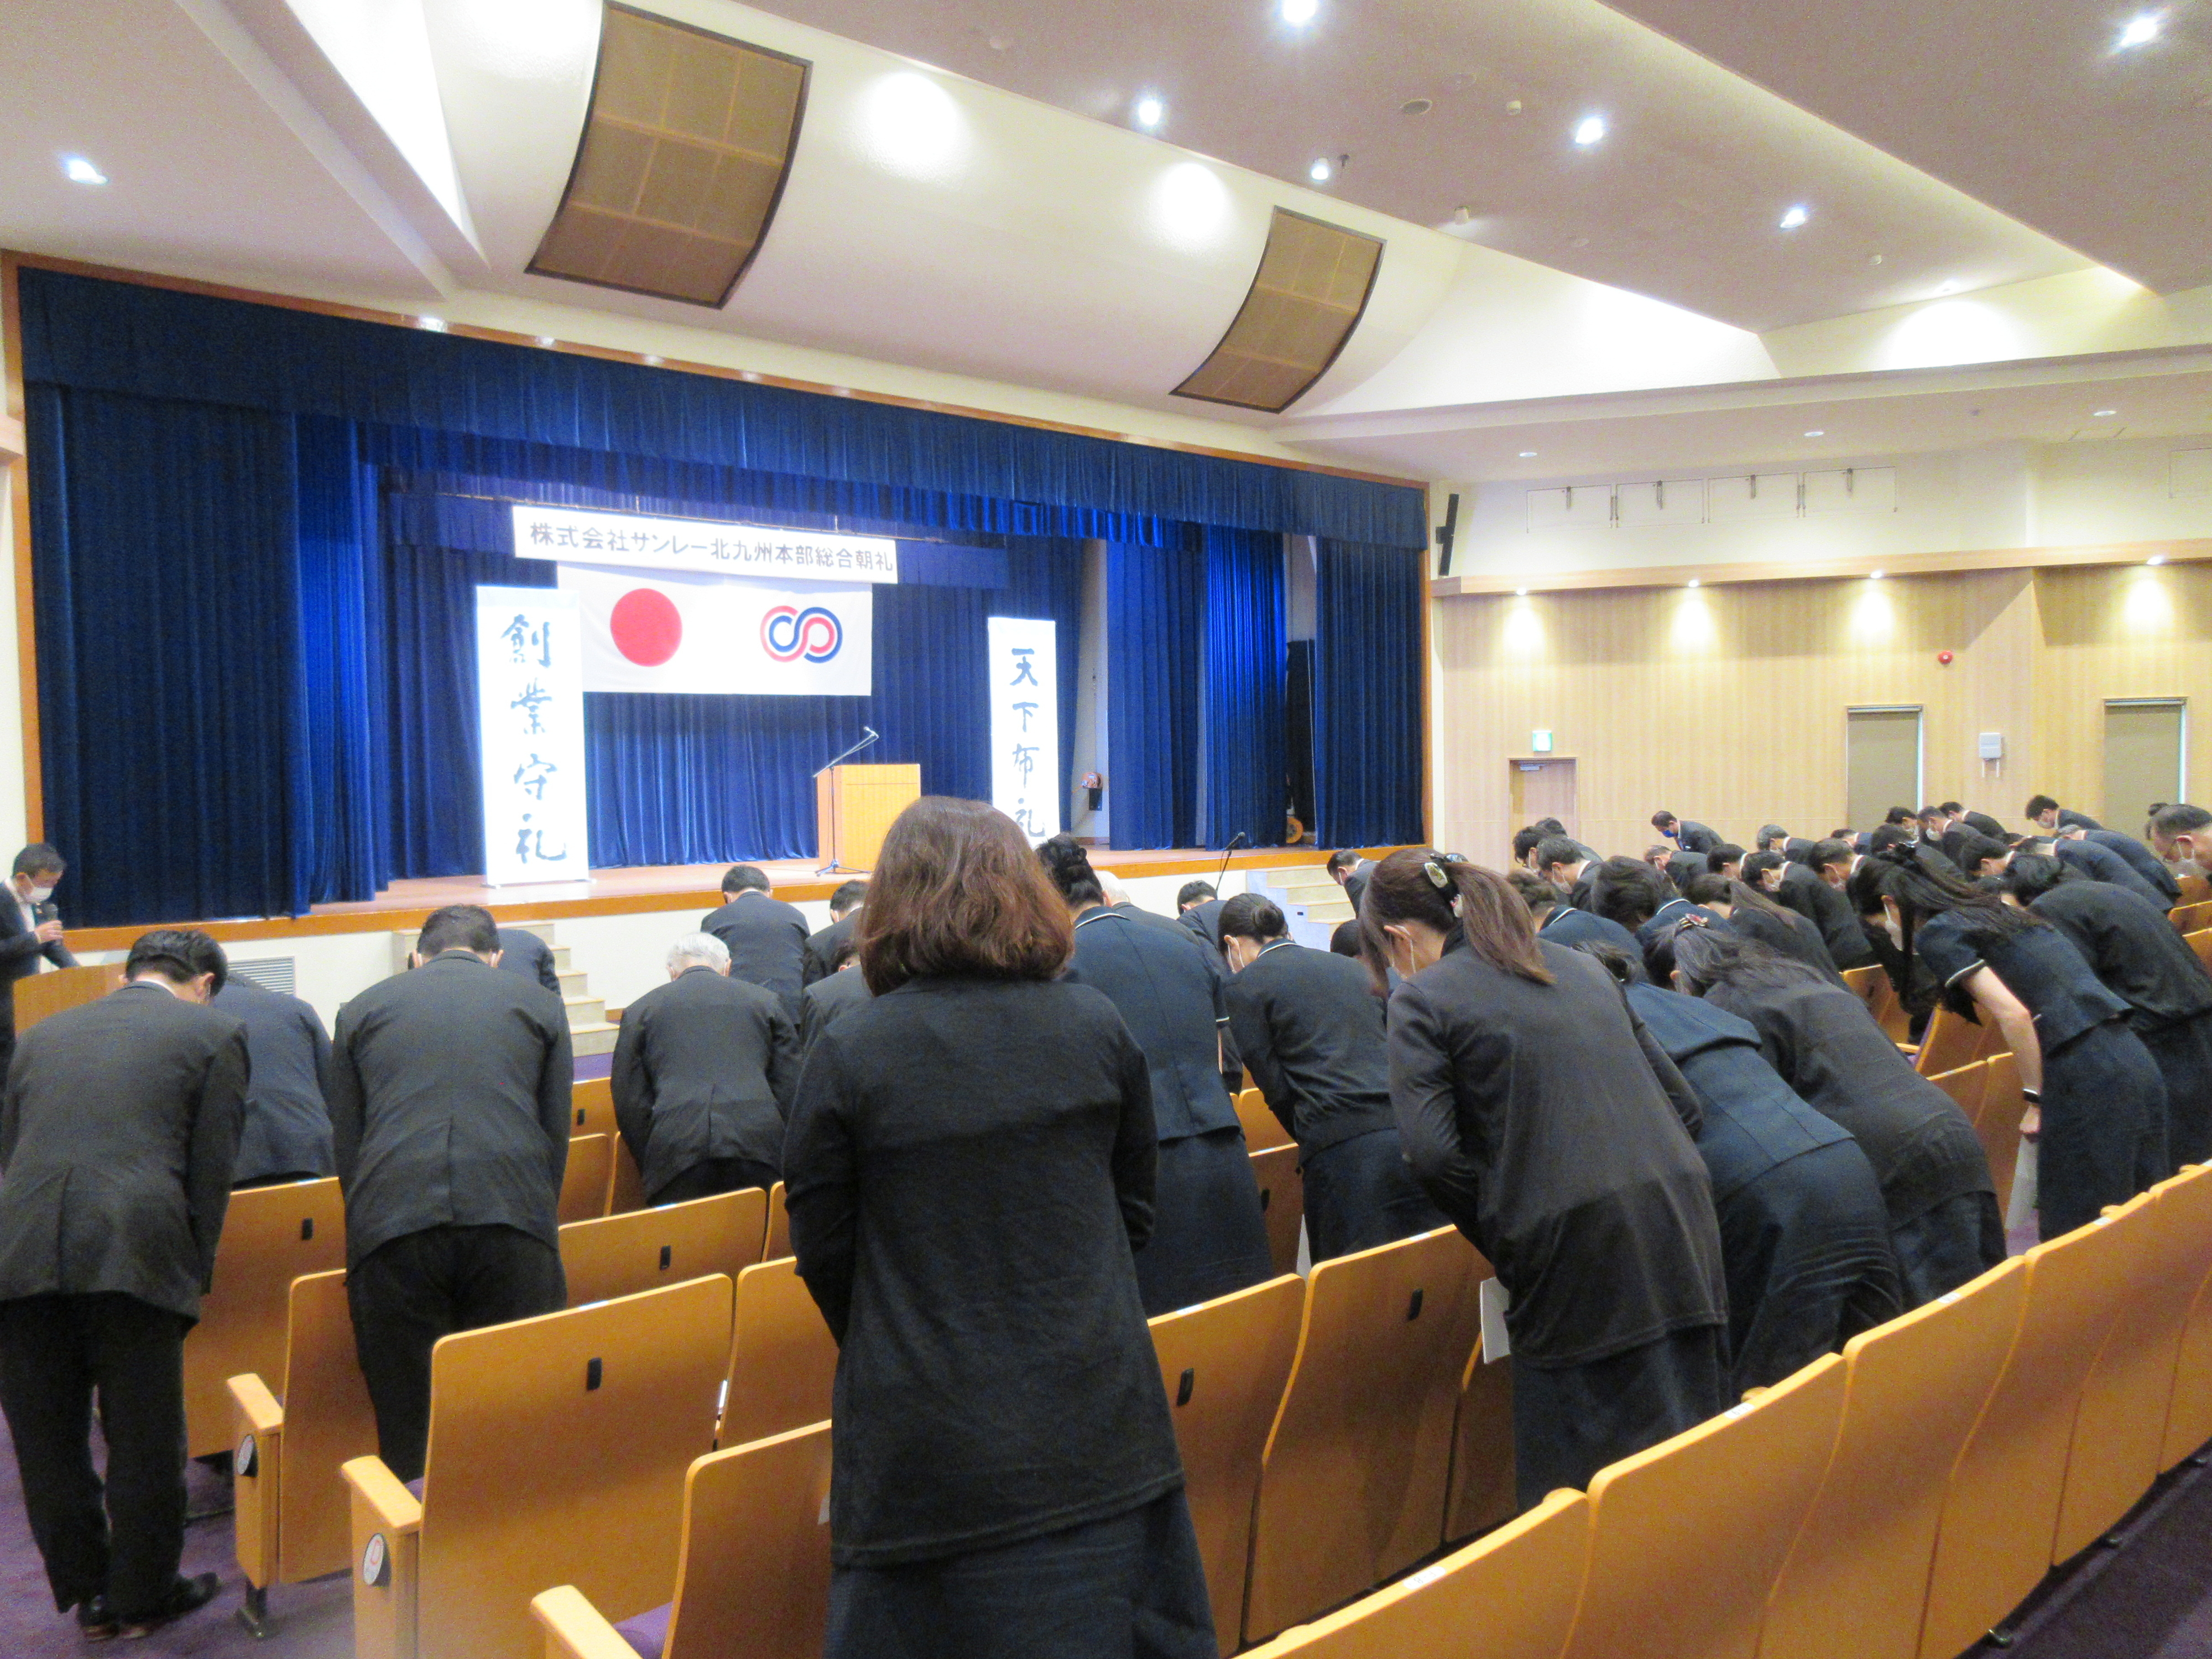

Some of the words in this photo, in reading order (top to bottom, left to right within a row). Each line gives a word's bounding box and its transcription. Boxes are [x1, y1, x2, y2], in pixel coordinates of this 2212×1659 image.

[530, 521, 894, 572] 株式会社サンレー北九州本部総合朝礼
[500, 614, 567, 864] 創業守礼
[1009, 648, 1045, 837] 天下布礼
